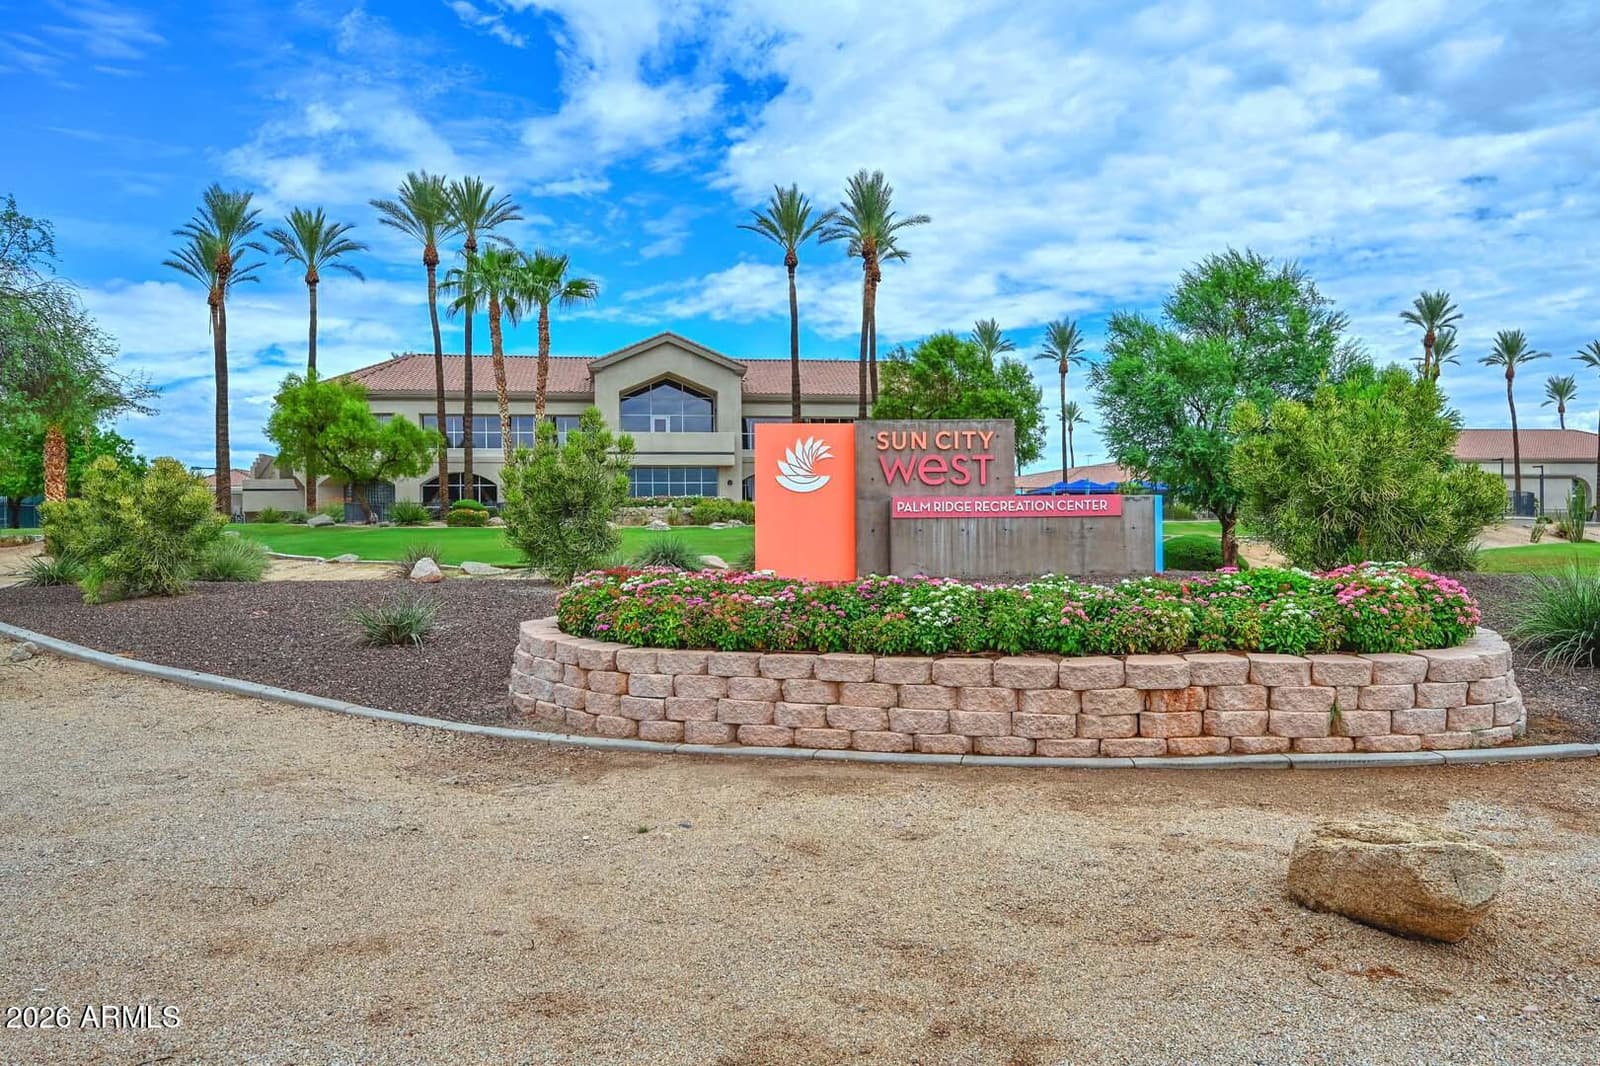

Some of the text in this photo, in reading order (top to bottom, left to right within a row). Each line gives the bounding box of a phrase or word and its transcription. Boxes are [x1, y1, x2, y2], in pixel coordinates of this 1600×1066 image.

[876, 431, 995, 450] SUN CITY
[896, 500, 1108, 513] PALM RIDGE RECREATION CENTER
